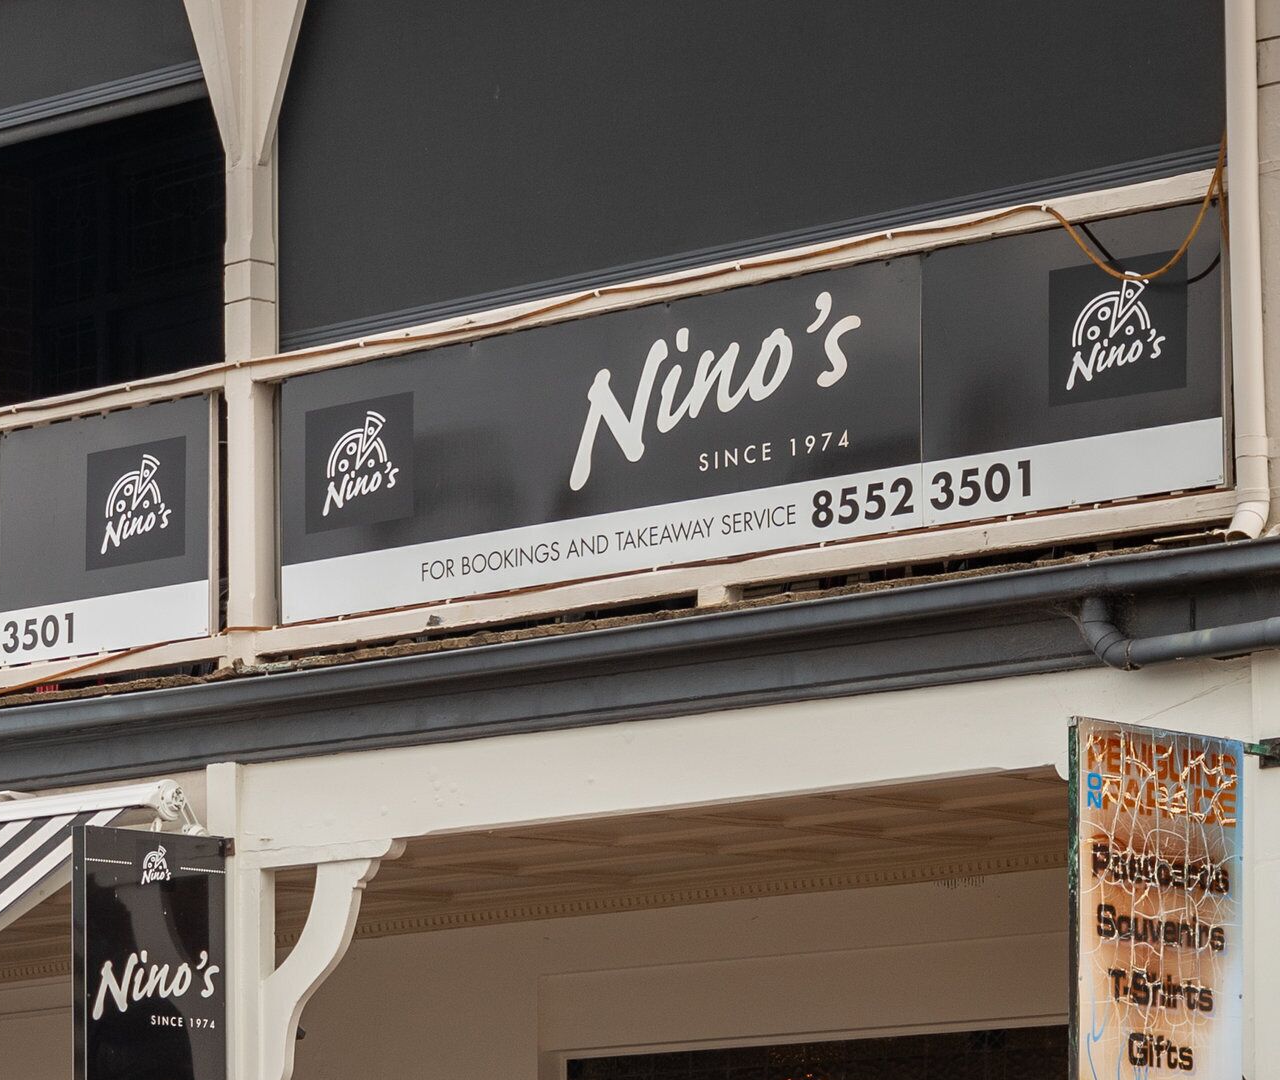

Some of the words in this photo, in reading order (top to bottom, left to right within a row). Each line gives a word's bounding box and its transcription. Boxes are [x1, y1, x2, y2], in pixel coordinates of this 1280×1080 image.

[1064, 327, 1167, 391] Nino's
[568, 290, 862, 492] Nino's
[697, 442, 773, 473] SINCE
[788, 429, 852, 456] 1974
[322, 459, 399, 517] Nino's
[100, 503, 171, 555] Nino's
[420, 557, 458, 583] FOR
[460, 540, 562, 579] BOOKINGS
[565, 531, 610, 562] AND
[615, 518, 716, 554] TAKEAWAY
[720, 503, 797, 539] SERVICE
[809, 475, 916, 530] 8552
[929, 457, 1034, 511] 3501
[2, 611, 76, 654] 3501
[1086, 733, 1237, 790] PENGUINS
[141, 868, 172, 885] Nino's
[1096, 903, 1225, 952] Souvenirs
[92, 950, 220, 1021] Nino's
[1108, 968, 1214, 1012] T-Shirts
[151, 1014, 184, 1027] SINCE
[190, 1018, 216, 1029] 1974
[1128, 1032, 1193, 1071] Gifts
